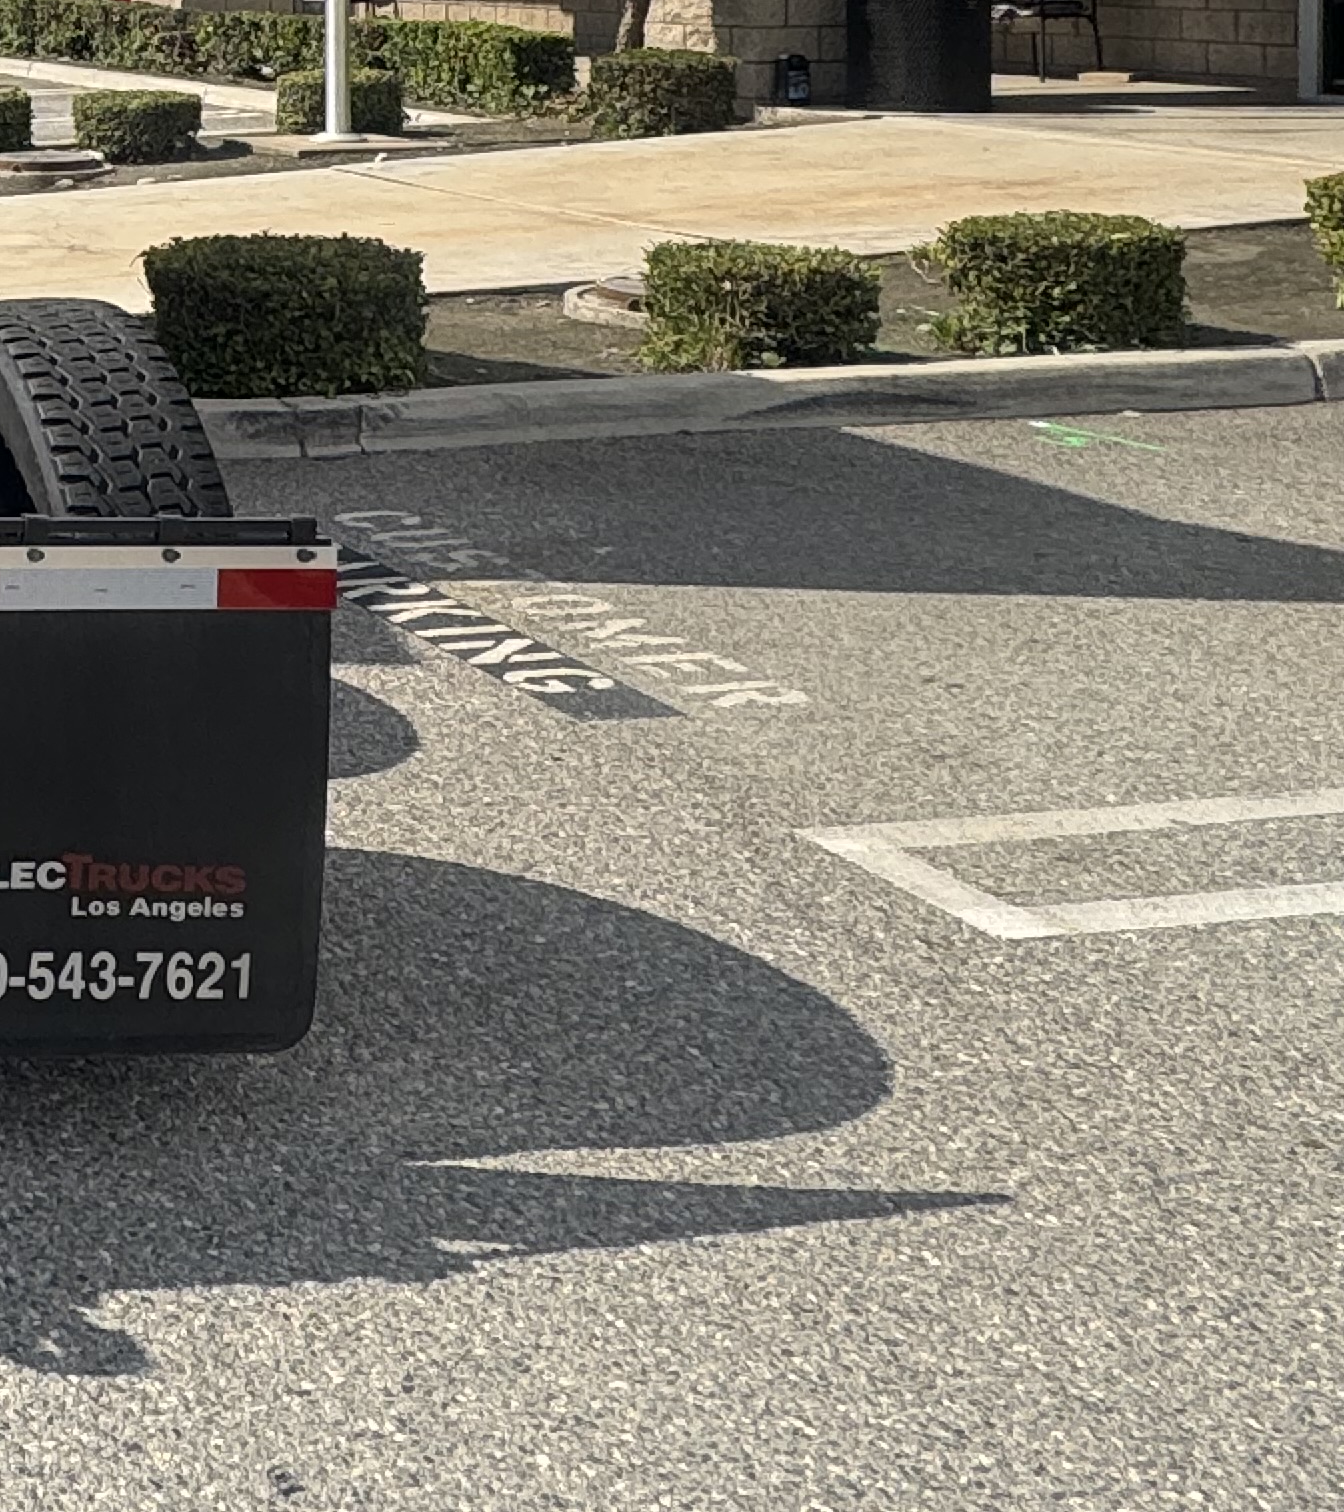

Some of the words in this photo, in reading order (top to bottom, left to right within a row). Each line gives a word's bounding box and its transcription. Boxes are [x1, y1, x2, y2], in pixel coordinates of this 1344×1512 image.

[334, 510, 810, 709] CUSOMER
[71, 896, 121, 918] Los
[129, 896, 245, 921] Angeles
